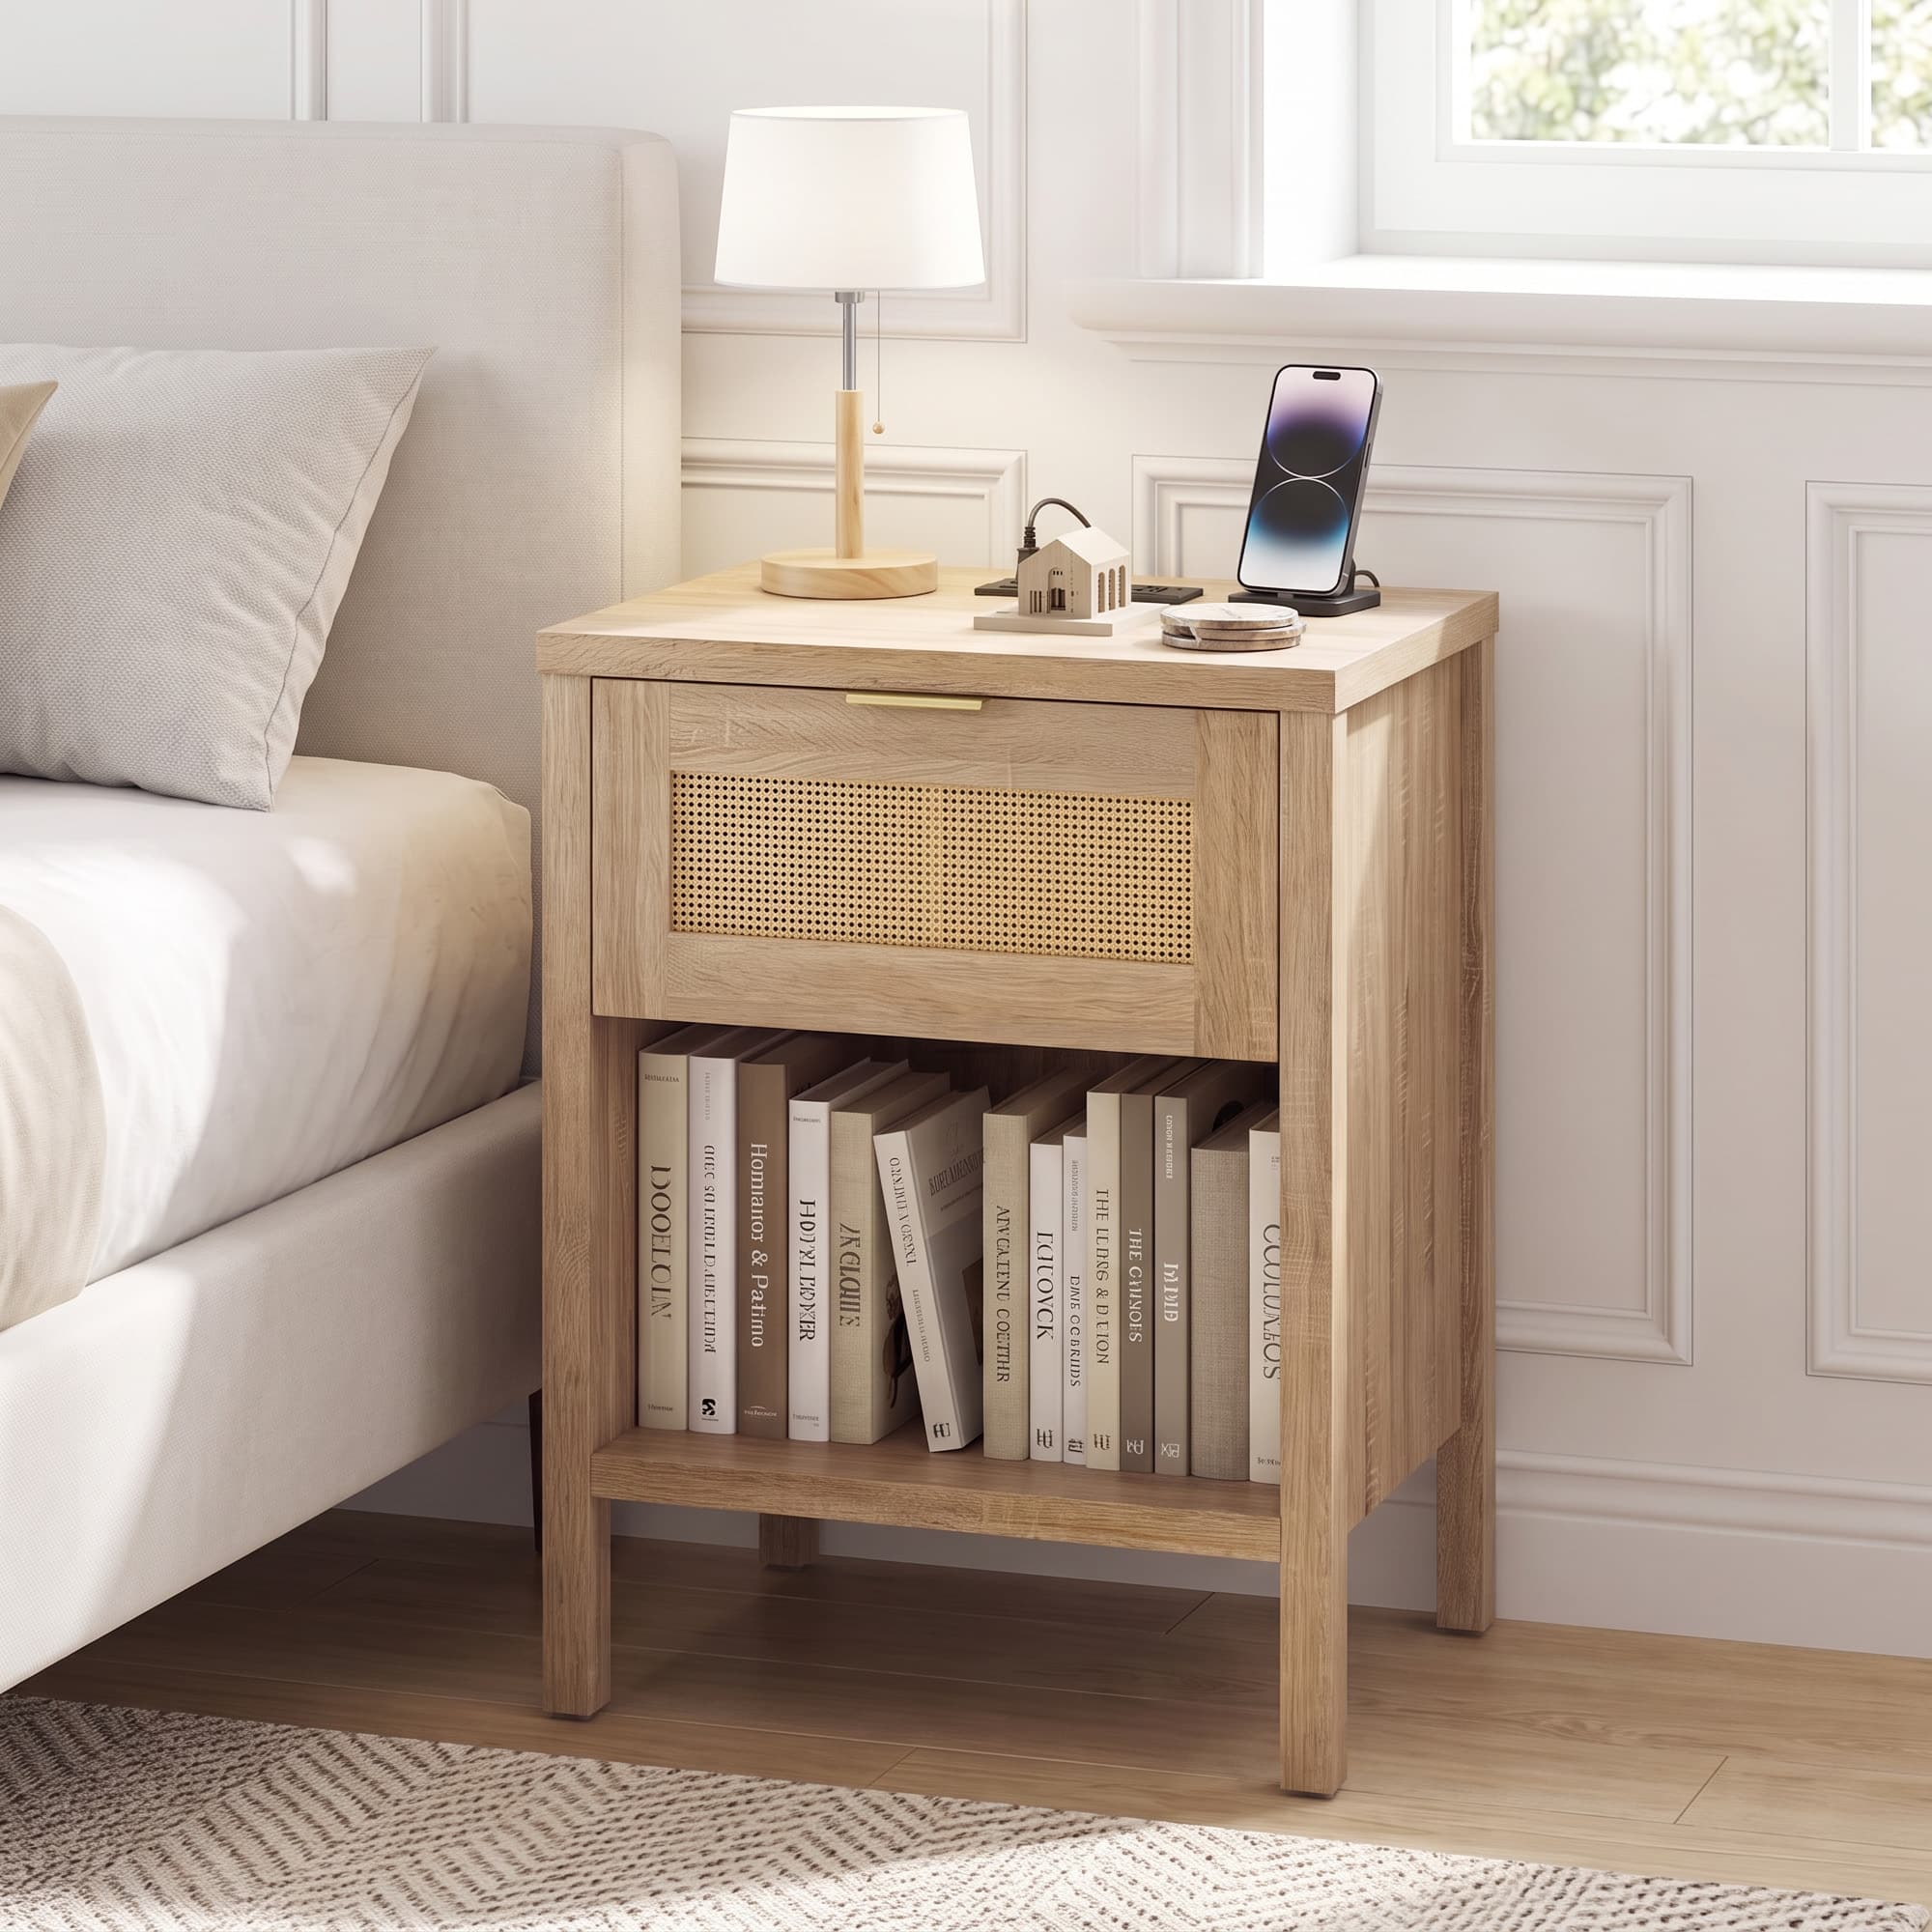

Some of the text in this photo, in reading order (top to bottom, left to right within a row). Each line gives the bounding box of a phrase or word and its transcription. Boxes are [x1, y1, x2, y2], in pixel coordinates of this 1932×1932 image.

[1095, 1189, 1110, 1221] THE
[1128, 1228, 1143, 1261] THE
[751, 1249, 770, 1266] &
[1096, 1287, 1110, 1299] &
